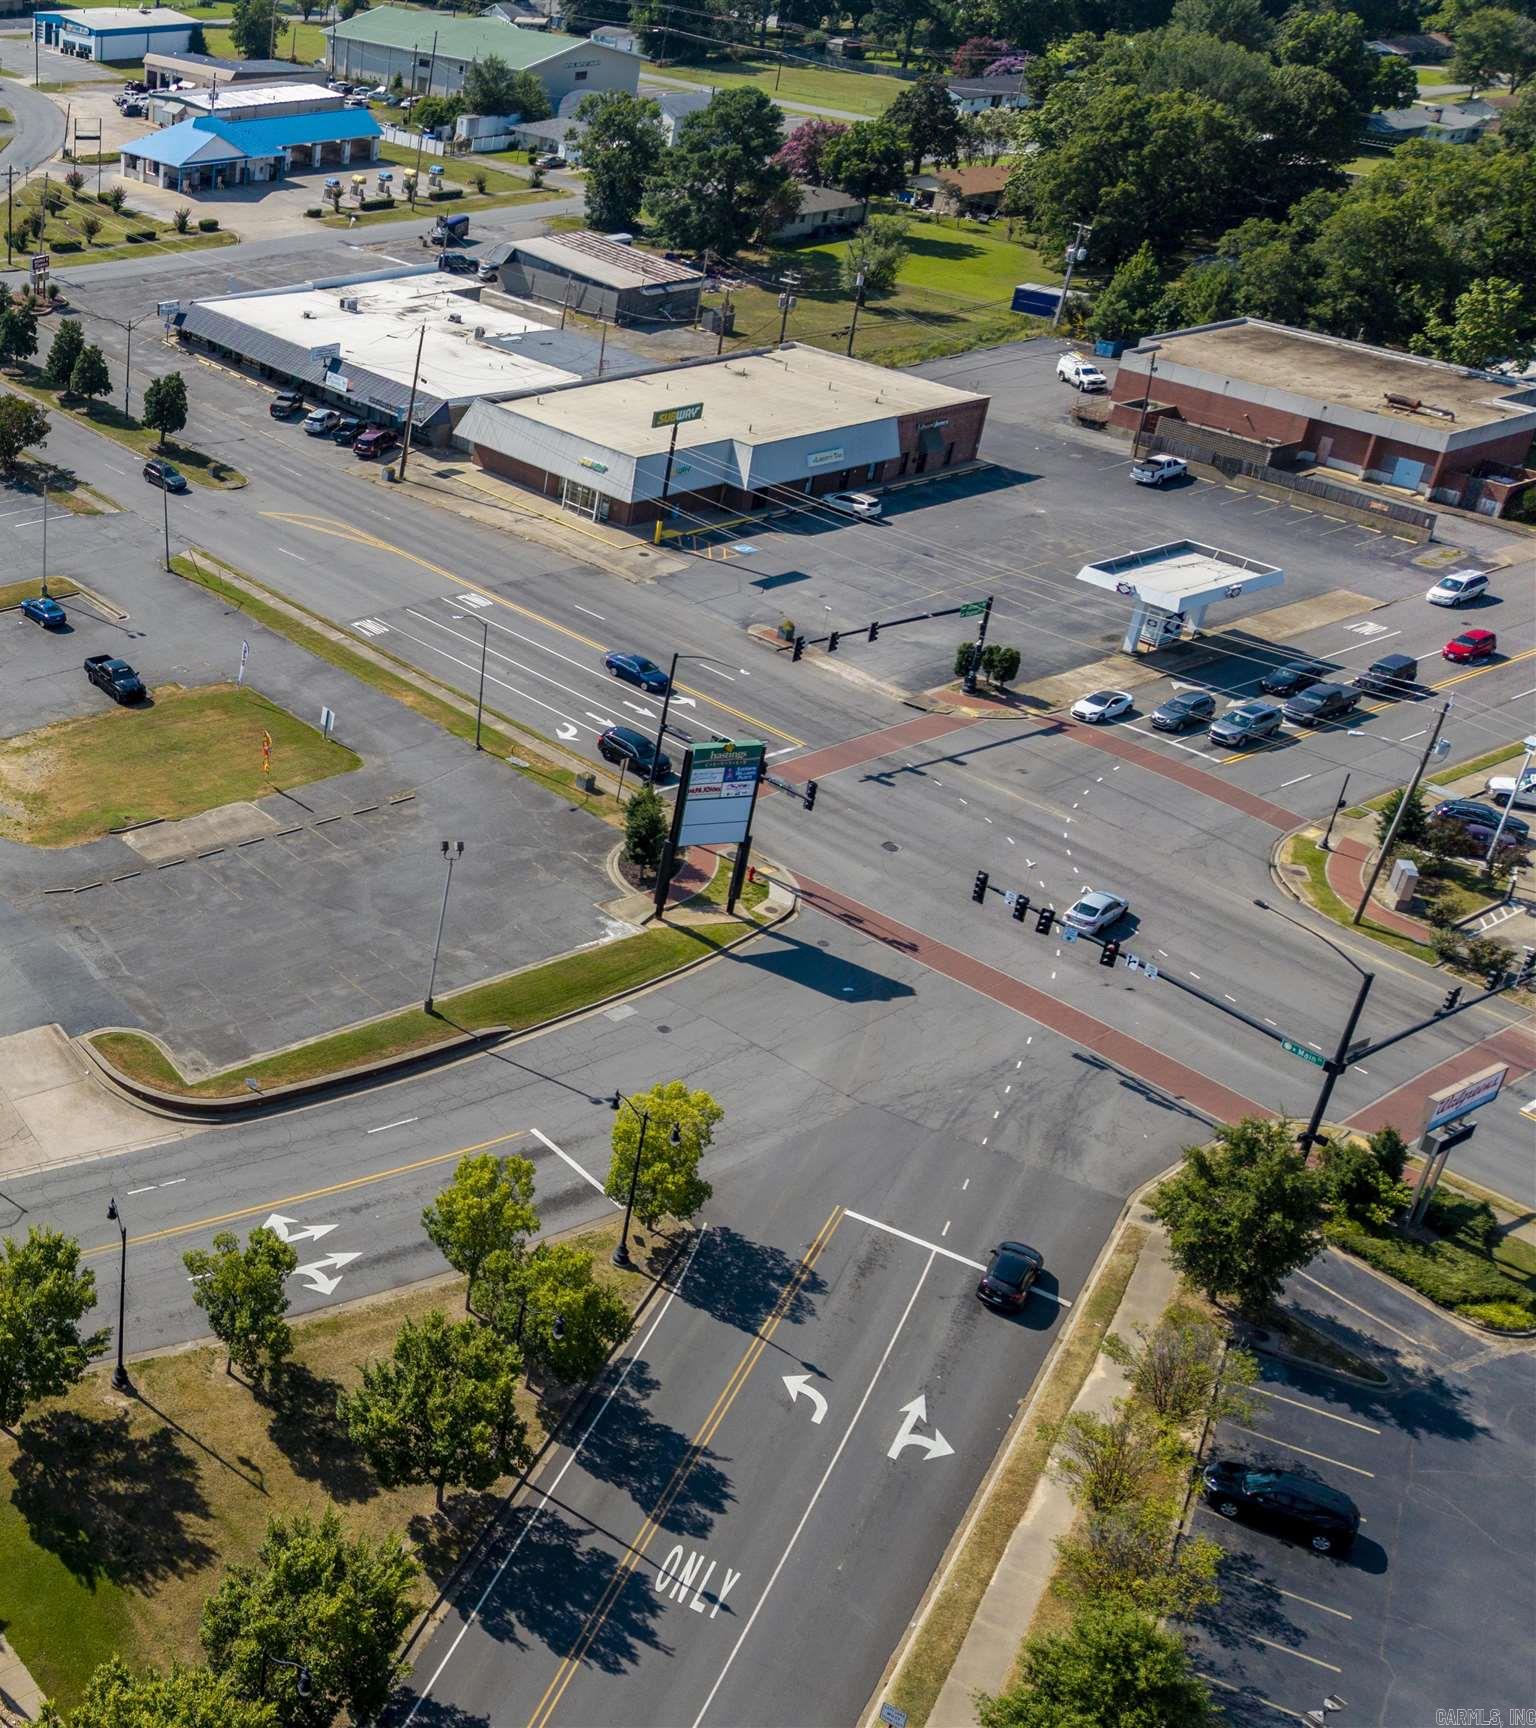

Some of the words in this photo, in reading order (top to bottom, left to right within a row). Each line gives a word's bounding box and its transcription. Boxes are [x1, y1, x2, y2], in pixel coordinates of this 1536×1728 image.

[657, 406, 701, 425] SUBWAY
[1297, 1048, 1318, 1063] Main
[655, 1544, 741, 1619] ONLY
